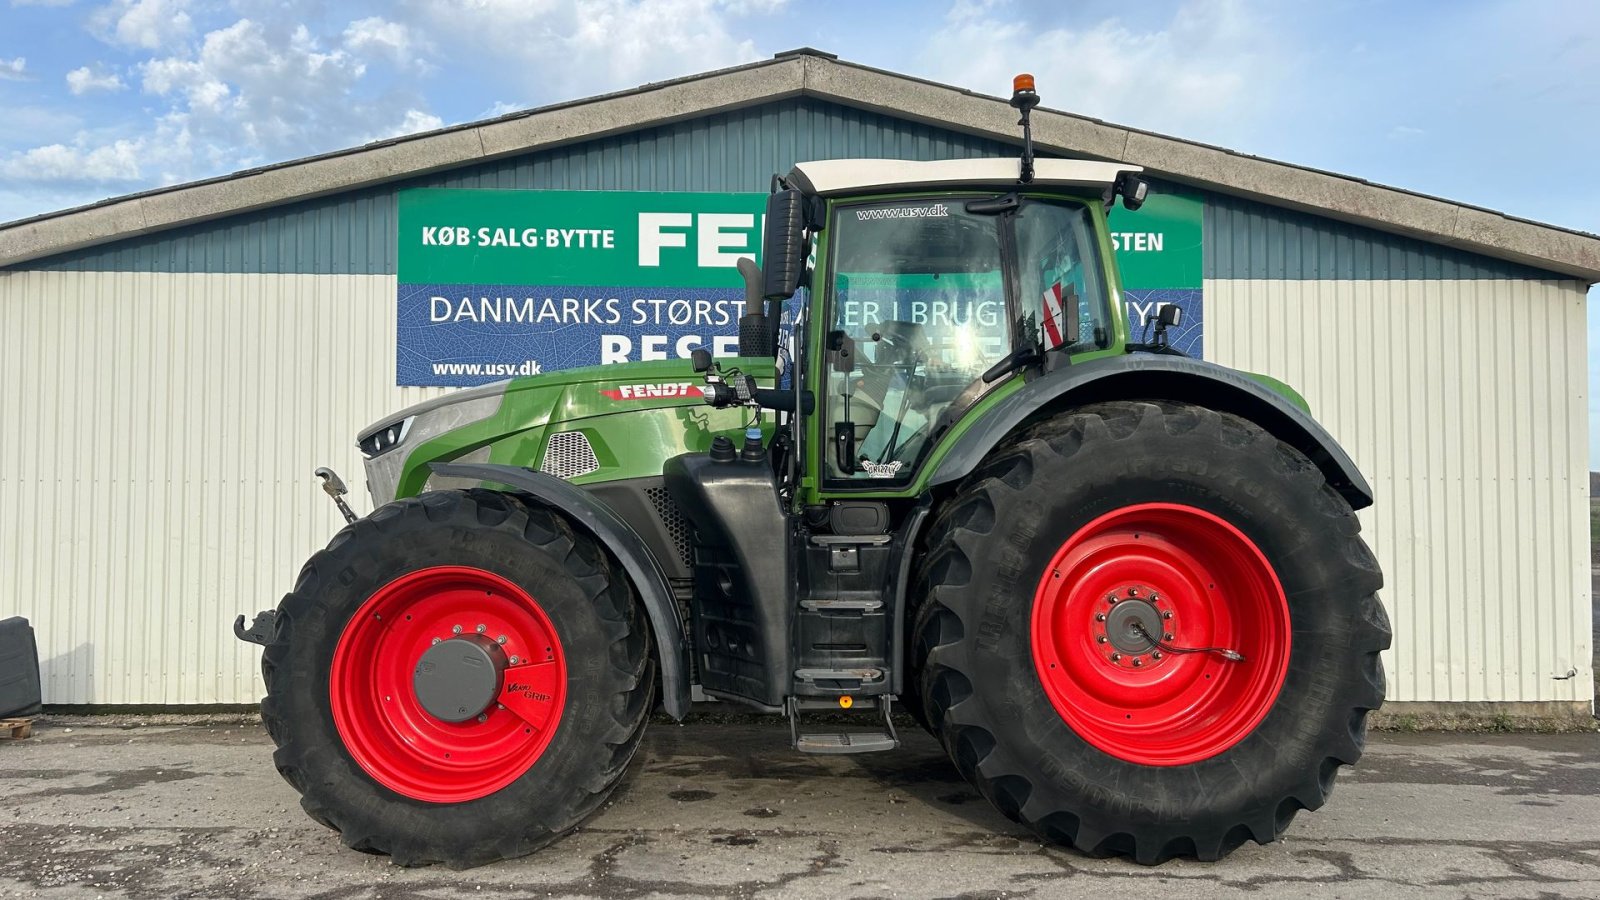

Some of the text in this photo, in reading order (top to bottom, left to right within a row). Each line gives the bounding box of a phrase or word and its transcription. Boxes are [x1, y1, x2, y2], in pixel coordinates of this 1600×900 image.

[856, 203, 949, 221] www.usv.dk
[638, 212, 766, 267] FE
[1110, 232, 1164, 252] STEN
[430, 297, 621, 324] DANMARKS
[632, 299, 747, 326] STØRST
[601, 334, 739, 366] RESE
[432, 360, 541, 376] www.usv.dk
[618, 382, 693, 399] FENDT
[524, 691, 551, 701] GRIP
